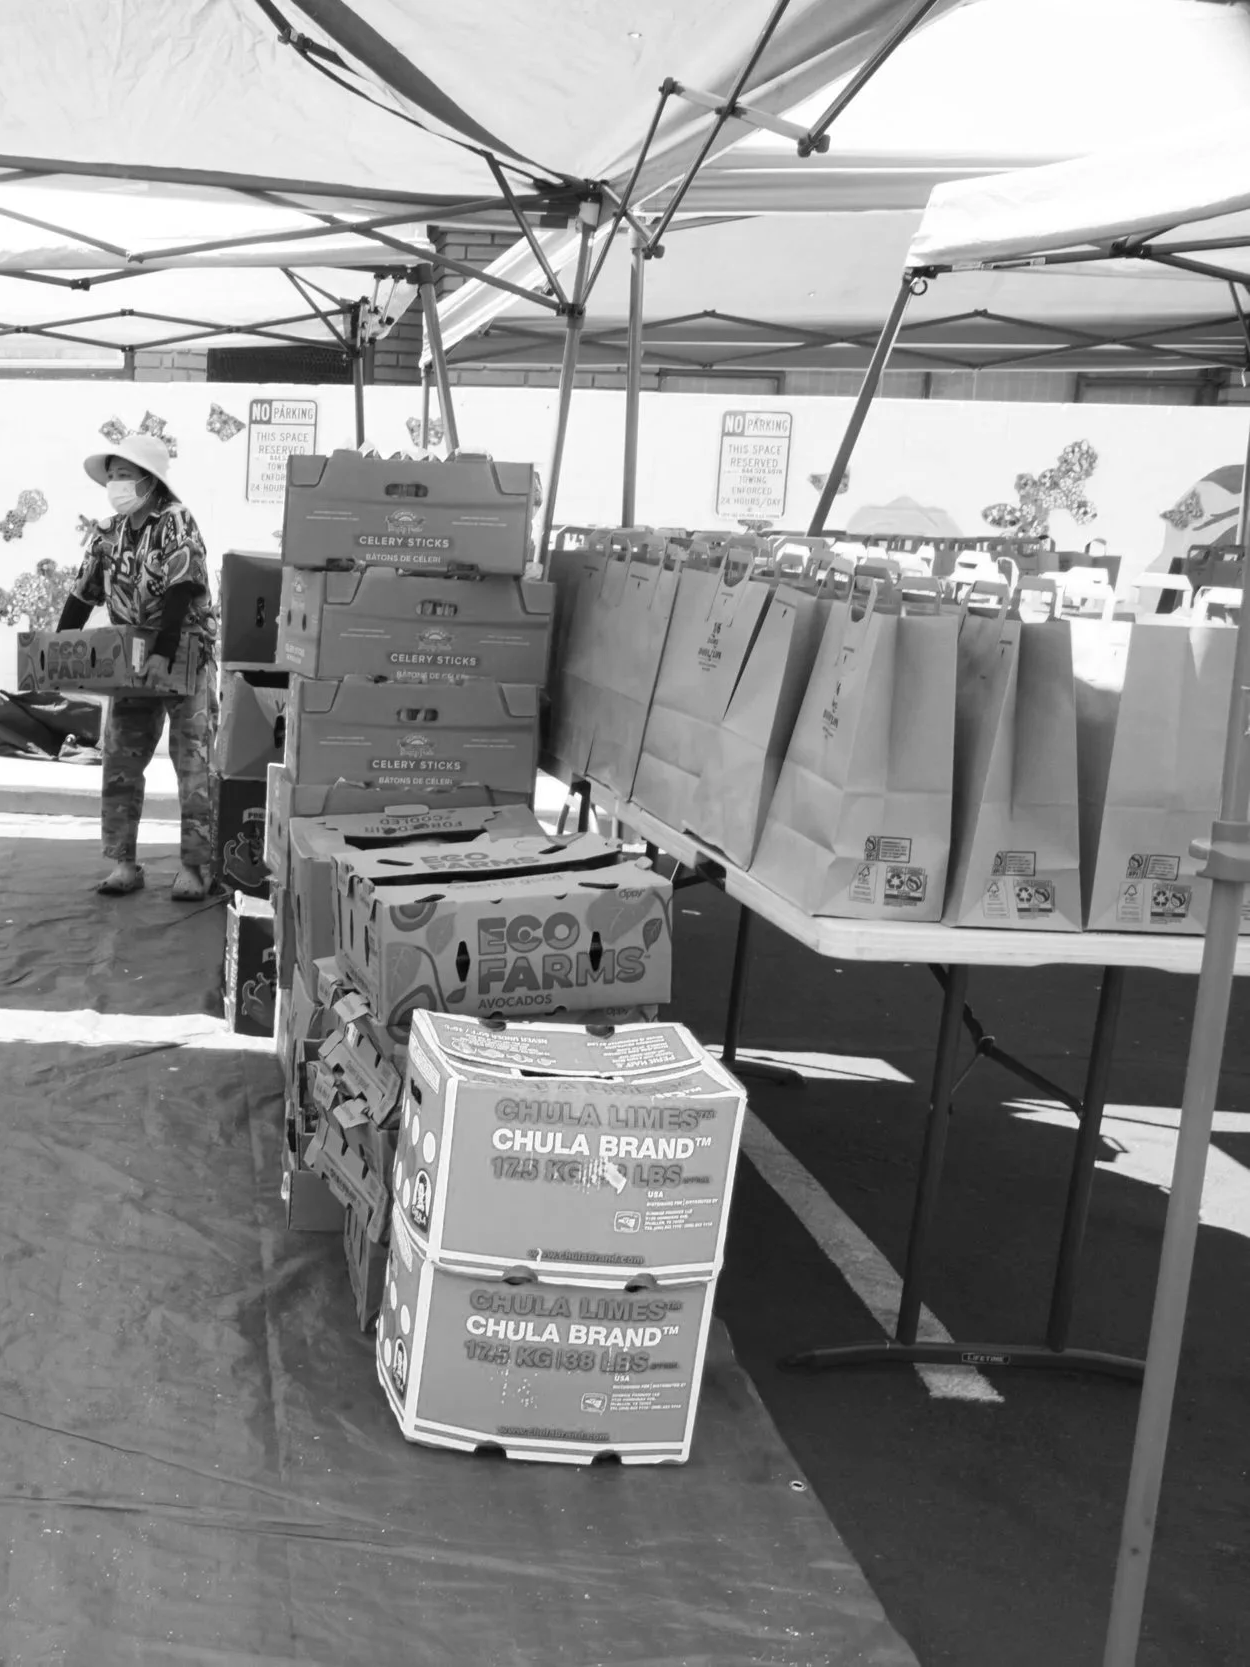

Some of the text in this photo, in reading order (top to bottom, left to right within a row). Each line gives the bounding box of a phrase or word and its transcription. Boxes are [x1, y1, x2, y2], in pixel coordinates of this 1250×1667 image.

[252, 403, 313, 421] NO PARKING
[724, 415, 788, 433] NO PARKING
[257, 432, 309, 442] THIS SPACE
[258, 445, 306, 455] RESERVED
[729, 444, 782, 455] THIS SPACE
[730, 457, 778, 468] RESERVED
[359, 534, 450, 549] CELERY STICKS
[400, 554, 411, 562] DE
[47, 639, 88, 661] ECO
[390, 653, 476, 667] CELERY STICKS
[47, 658, 115, 681] FARMS
[372, 759, 461, 771] CELERY STICKS
[411, 777, 423, 785] DE
[420, 852, 490, 865] ECO
[424, 856, 540, 871] FARMS
[478, 912, 581, 956] ECO
[478, 946, 651, 995] FARMS
[478, 994, 552, 1010] AVOCADOS
[494, 1097, 602, 1129] CHULA
[492, 1127, 590, 1157] CHULA
[490, 1155, 539, 1181] 17.5
[631, 1164, 683, 1188] LBS
[466, 1288, 571, 1320] CHULA
[465, 1314, 560, 1343] CHULA
[464, 1339, 511, 1365] 17.5
[600, 1350, 651, 1374] LBS
[614, 1374, 630, 1382] USA
